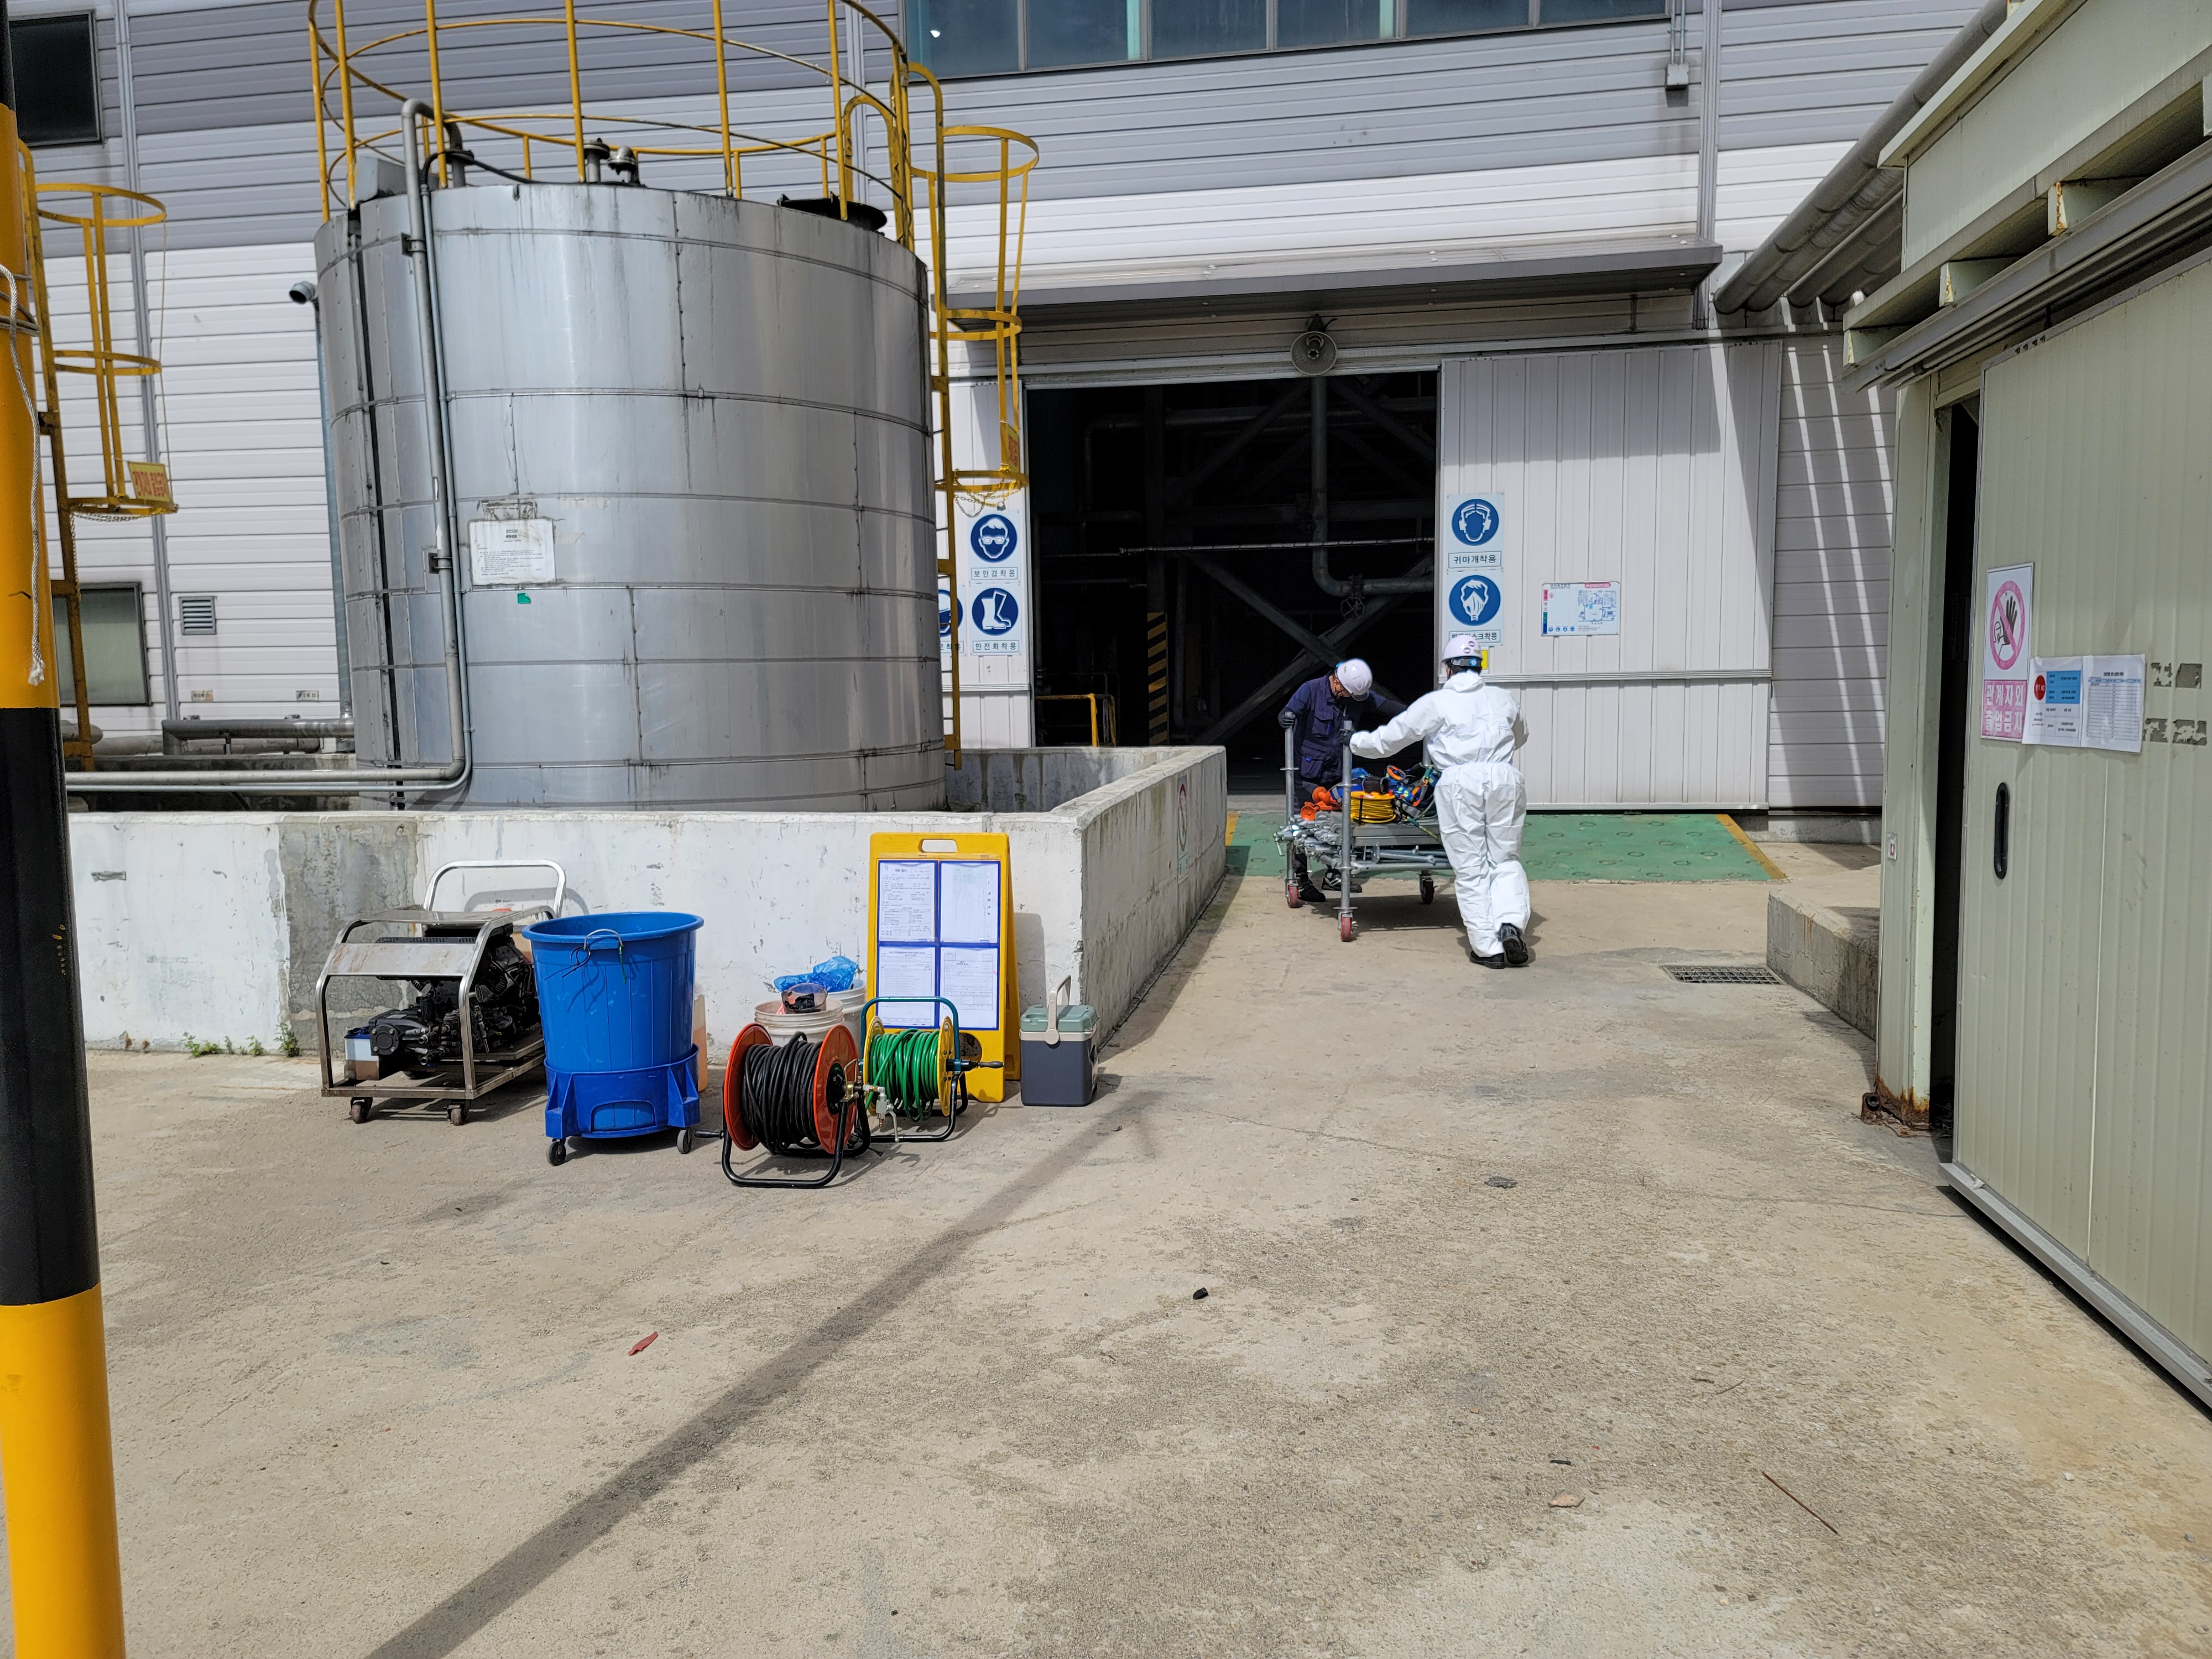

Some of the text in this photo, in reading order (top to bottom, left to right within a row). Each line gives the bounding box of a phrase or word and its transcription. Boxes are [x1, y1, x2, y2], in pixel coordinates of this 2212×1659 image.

[1453, 555, 1497, 565] 귀마개착용
[975, 642, 1016, 650] 안전화착용
[1986, 685, 2024, 707] 관계자외
[1985, 709, 2023, 733] 출입금지
